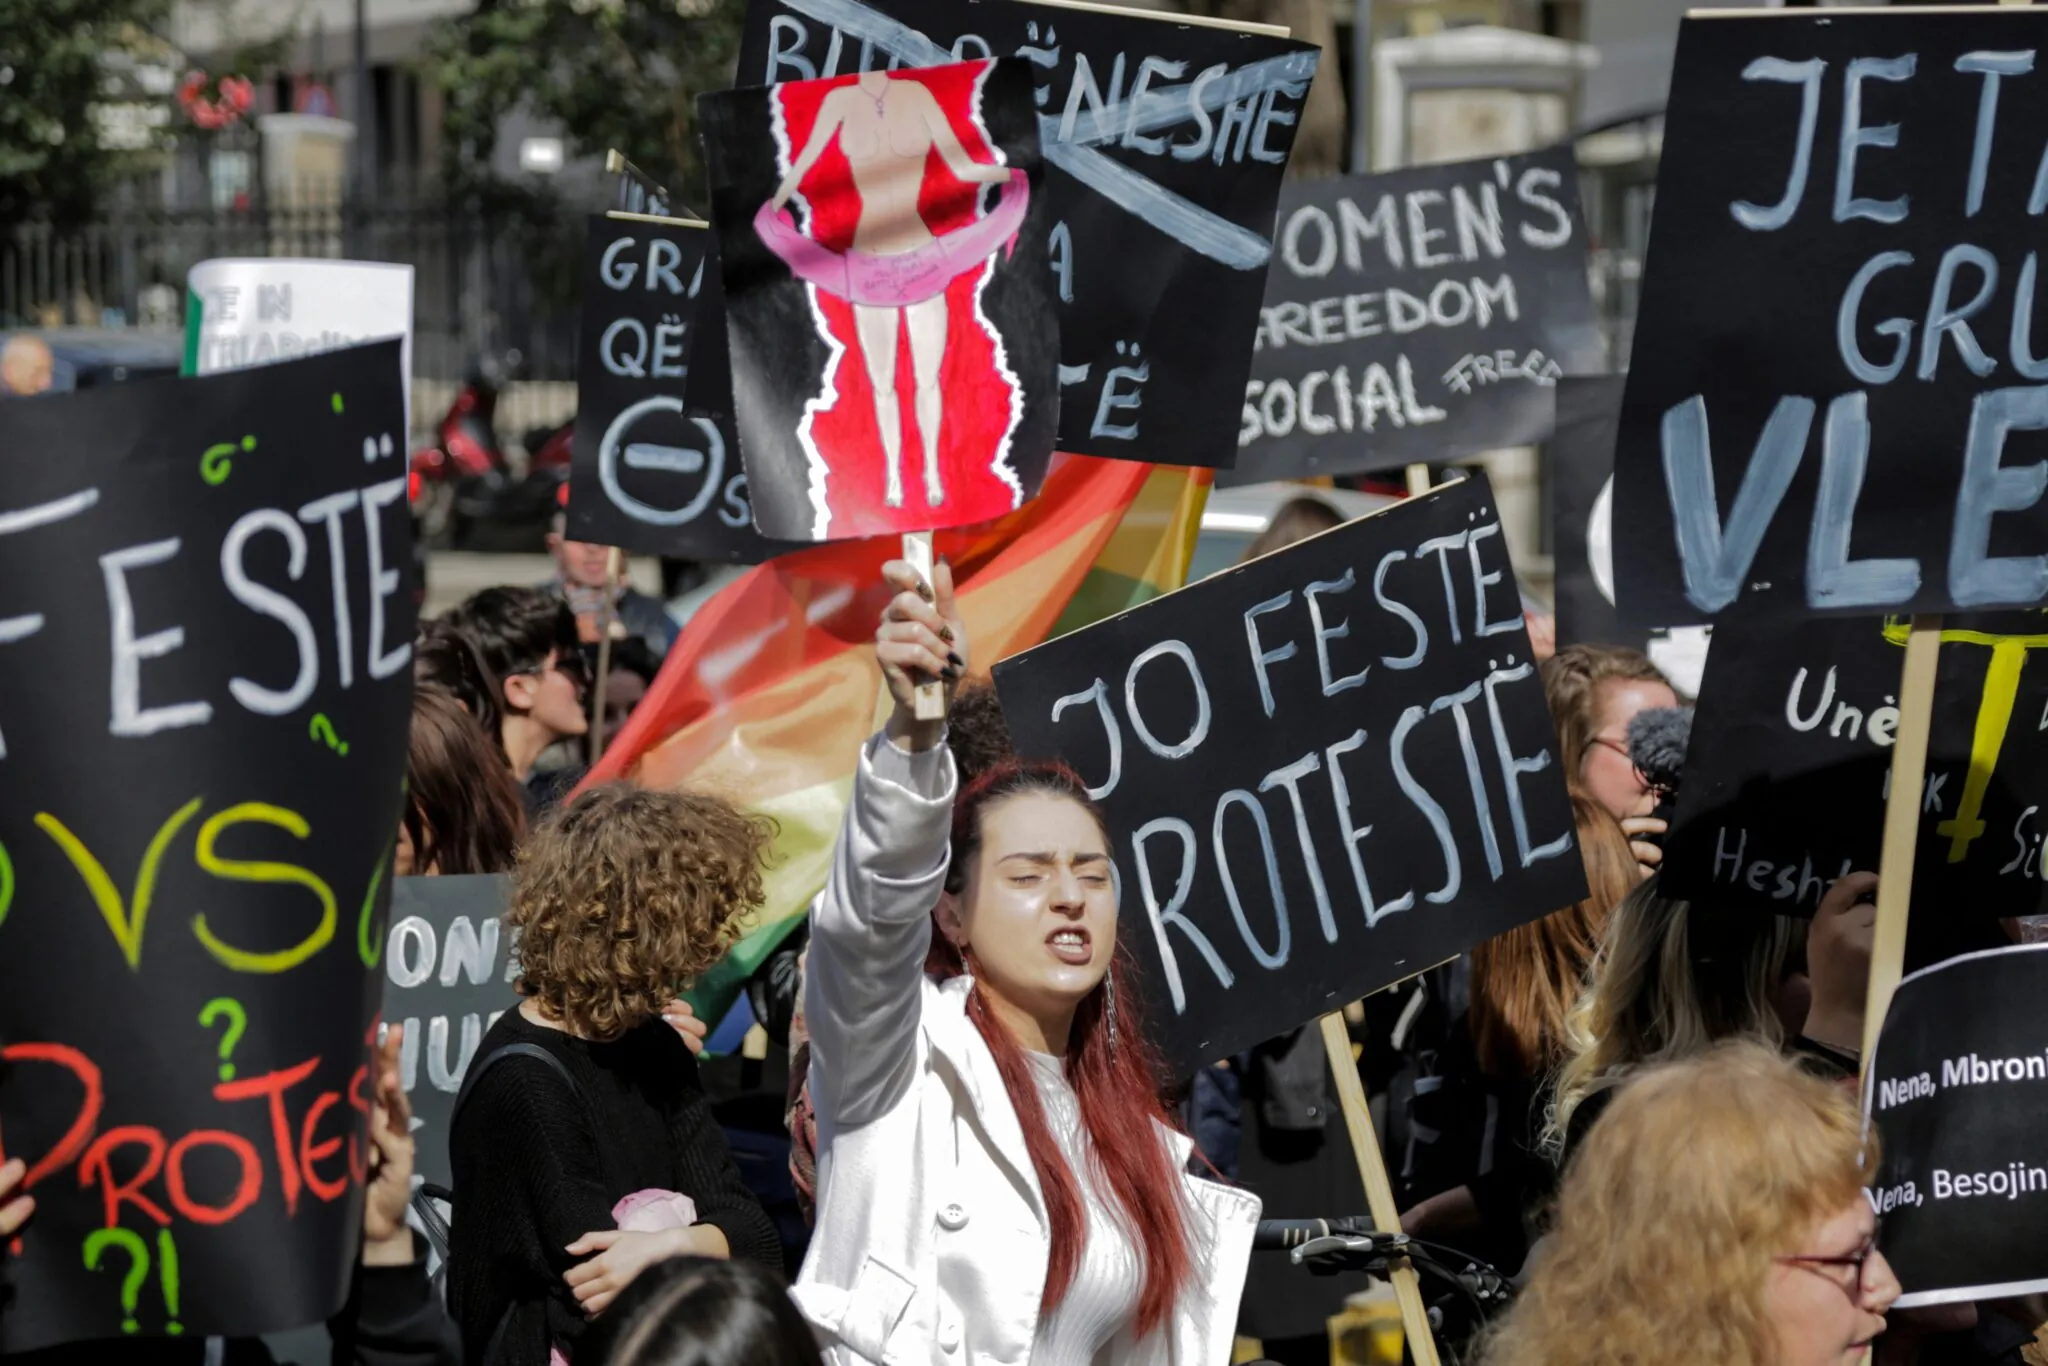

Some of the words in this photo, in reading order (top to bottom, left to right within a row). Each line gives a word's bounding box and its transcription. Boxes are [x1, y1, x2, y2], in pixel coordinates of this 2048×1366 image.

[1281, 159, 1573, 278] OMEN'S
[1051, 637, 1212, 801] JO
[1243, 505, 1524, 719] FESTË
[1107, 653, 1574, 1016] ROTESTË
[1879, 1071, 1936, 1110] Nena,
